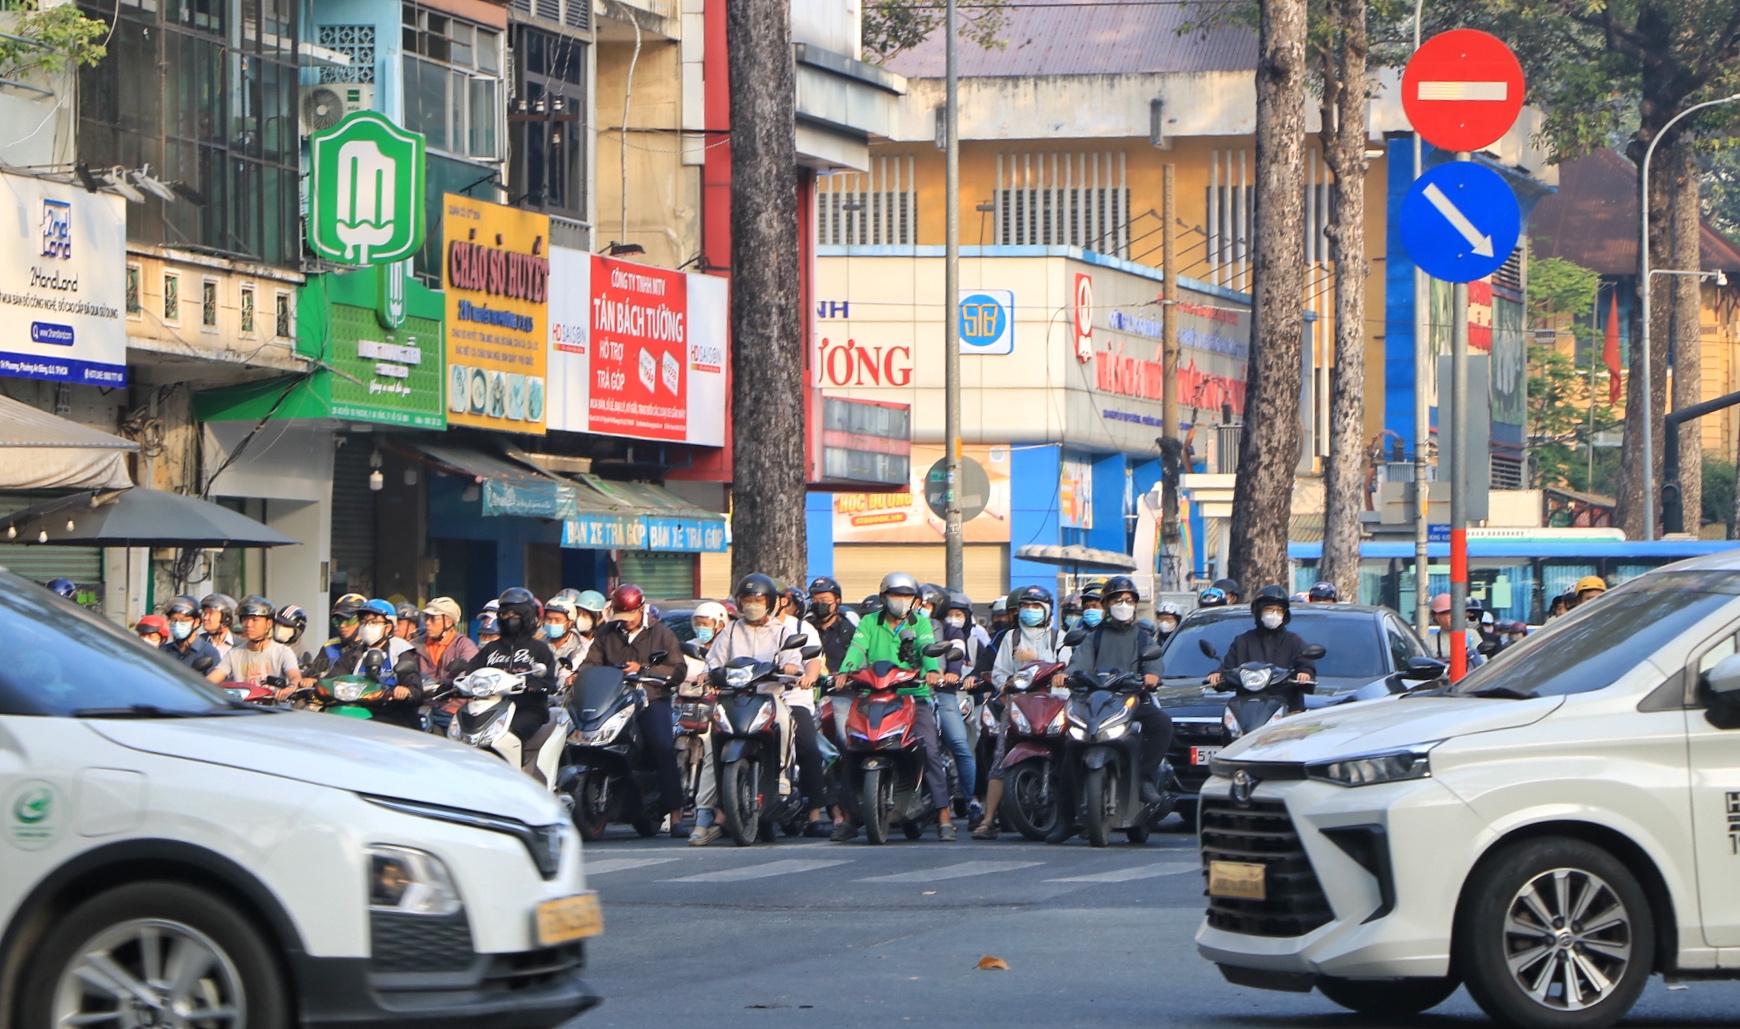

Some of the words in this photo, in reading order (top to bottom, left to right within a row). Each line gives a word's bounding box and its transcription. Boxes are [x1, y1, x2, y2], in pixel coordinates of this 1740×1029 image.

[30, 266, 78, 292] 2HandLand
[449, 228, 487, 292] CHÁO
[487, 233, 507, 296] SÒ
[505, 235, 550, 304] HUYẾT
[611, 267, 628, 290] CÔNG
[627, 272, 636, 292] TY
[636, 274, 652, 294] TNHH
[652, 277, 666, 296] MTV
[594, 292, 615, 333] TÂN
[617, 297, 645, 338] BÁCH
[646, 303, 684, 344] TƯỜNG
[597, 368, 611, 391] TRẢ
[611, 369, 626, 392] GÓP
[838, 493, 866, 516] HỌC
[590, 522, 603, 545] XE
[626, 519, 646, 546] GÓP
[672, 524, 684, 548] XE
[1198, 750, 1217, 762] 51
